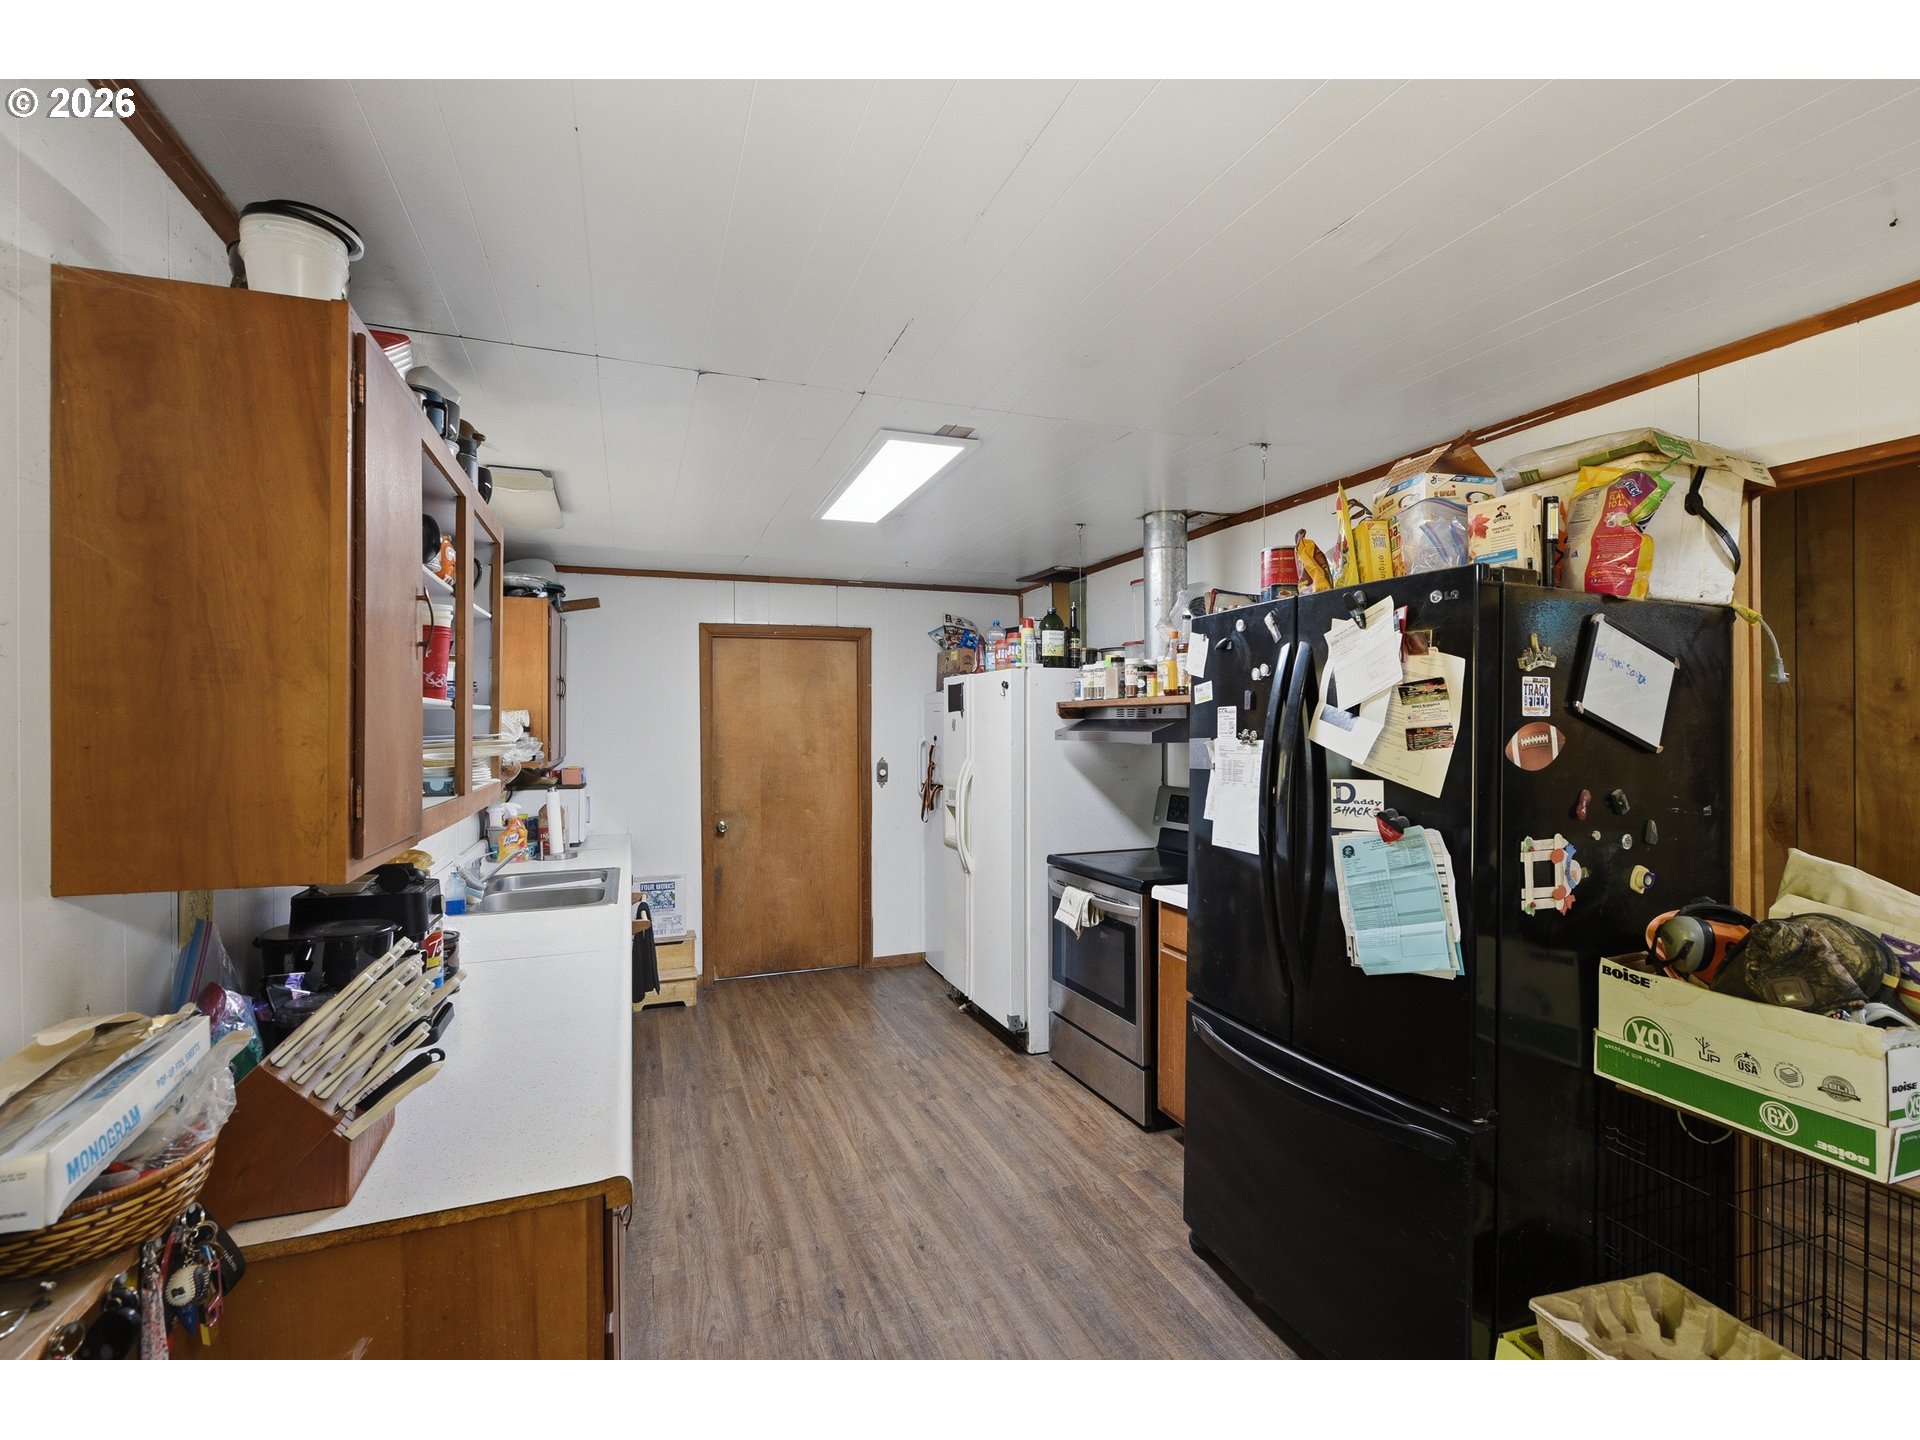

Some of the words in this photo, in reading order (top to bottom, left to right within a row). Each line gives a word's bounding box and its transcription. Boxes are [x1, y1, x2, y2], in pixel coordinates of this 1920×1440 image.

[1523, 683, 1549, 697] TRACK
[1333, 806, 1374, 818] SHACK
[1737, 1060, 1759, 1076] USA
[66, 1104, 141, 1185] MONOGRAM
